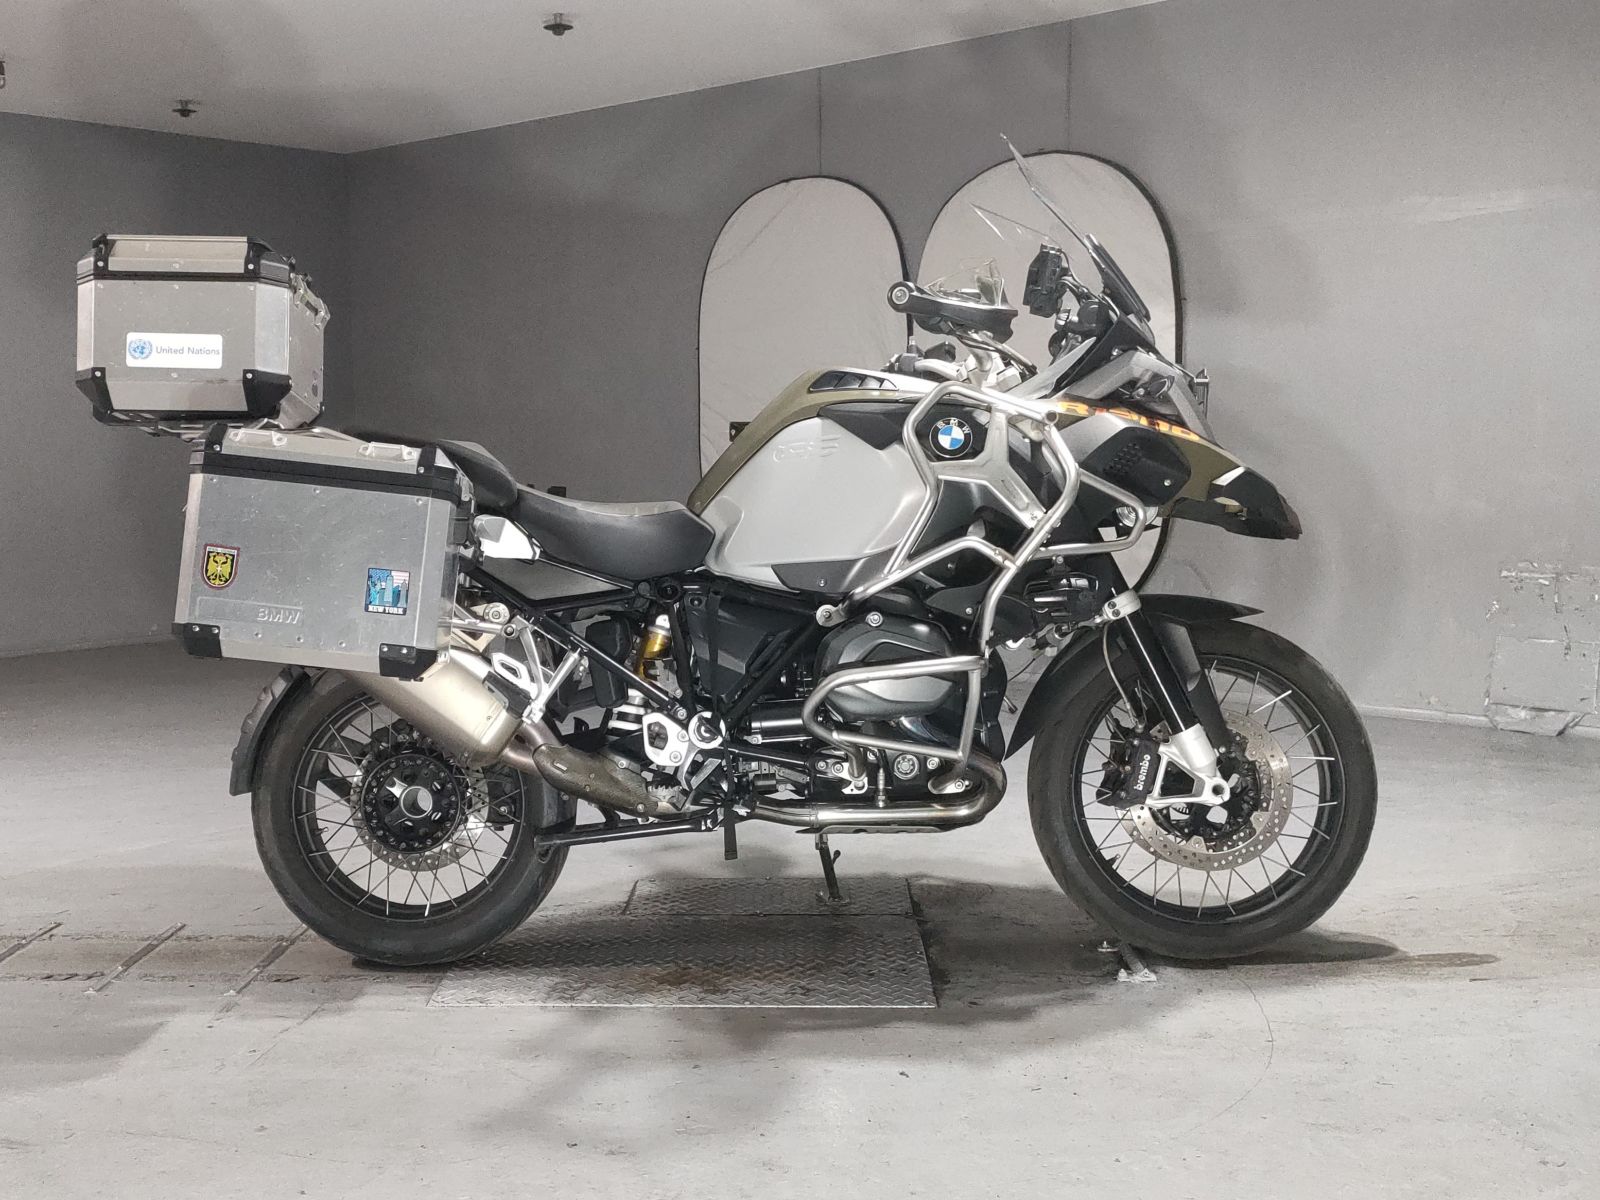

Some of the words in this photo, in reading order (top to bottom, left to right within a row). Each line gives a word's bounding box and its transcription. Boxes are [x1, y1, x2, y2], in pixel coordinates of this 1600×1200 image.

[155, 345, 185, 355] United
[187, 346, 220, 356] Nations
[936, 418, 971, 434] BMW
[256, 607, 300, 624] BMW
[368, 604, 385, 613] NEW
[385, 606, 404, 615] YORK
[1133, 754, 1151, 791] brembo
